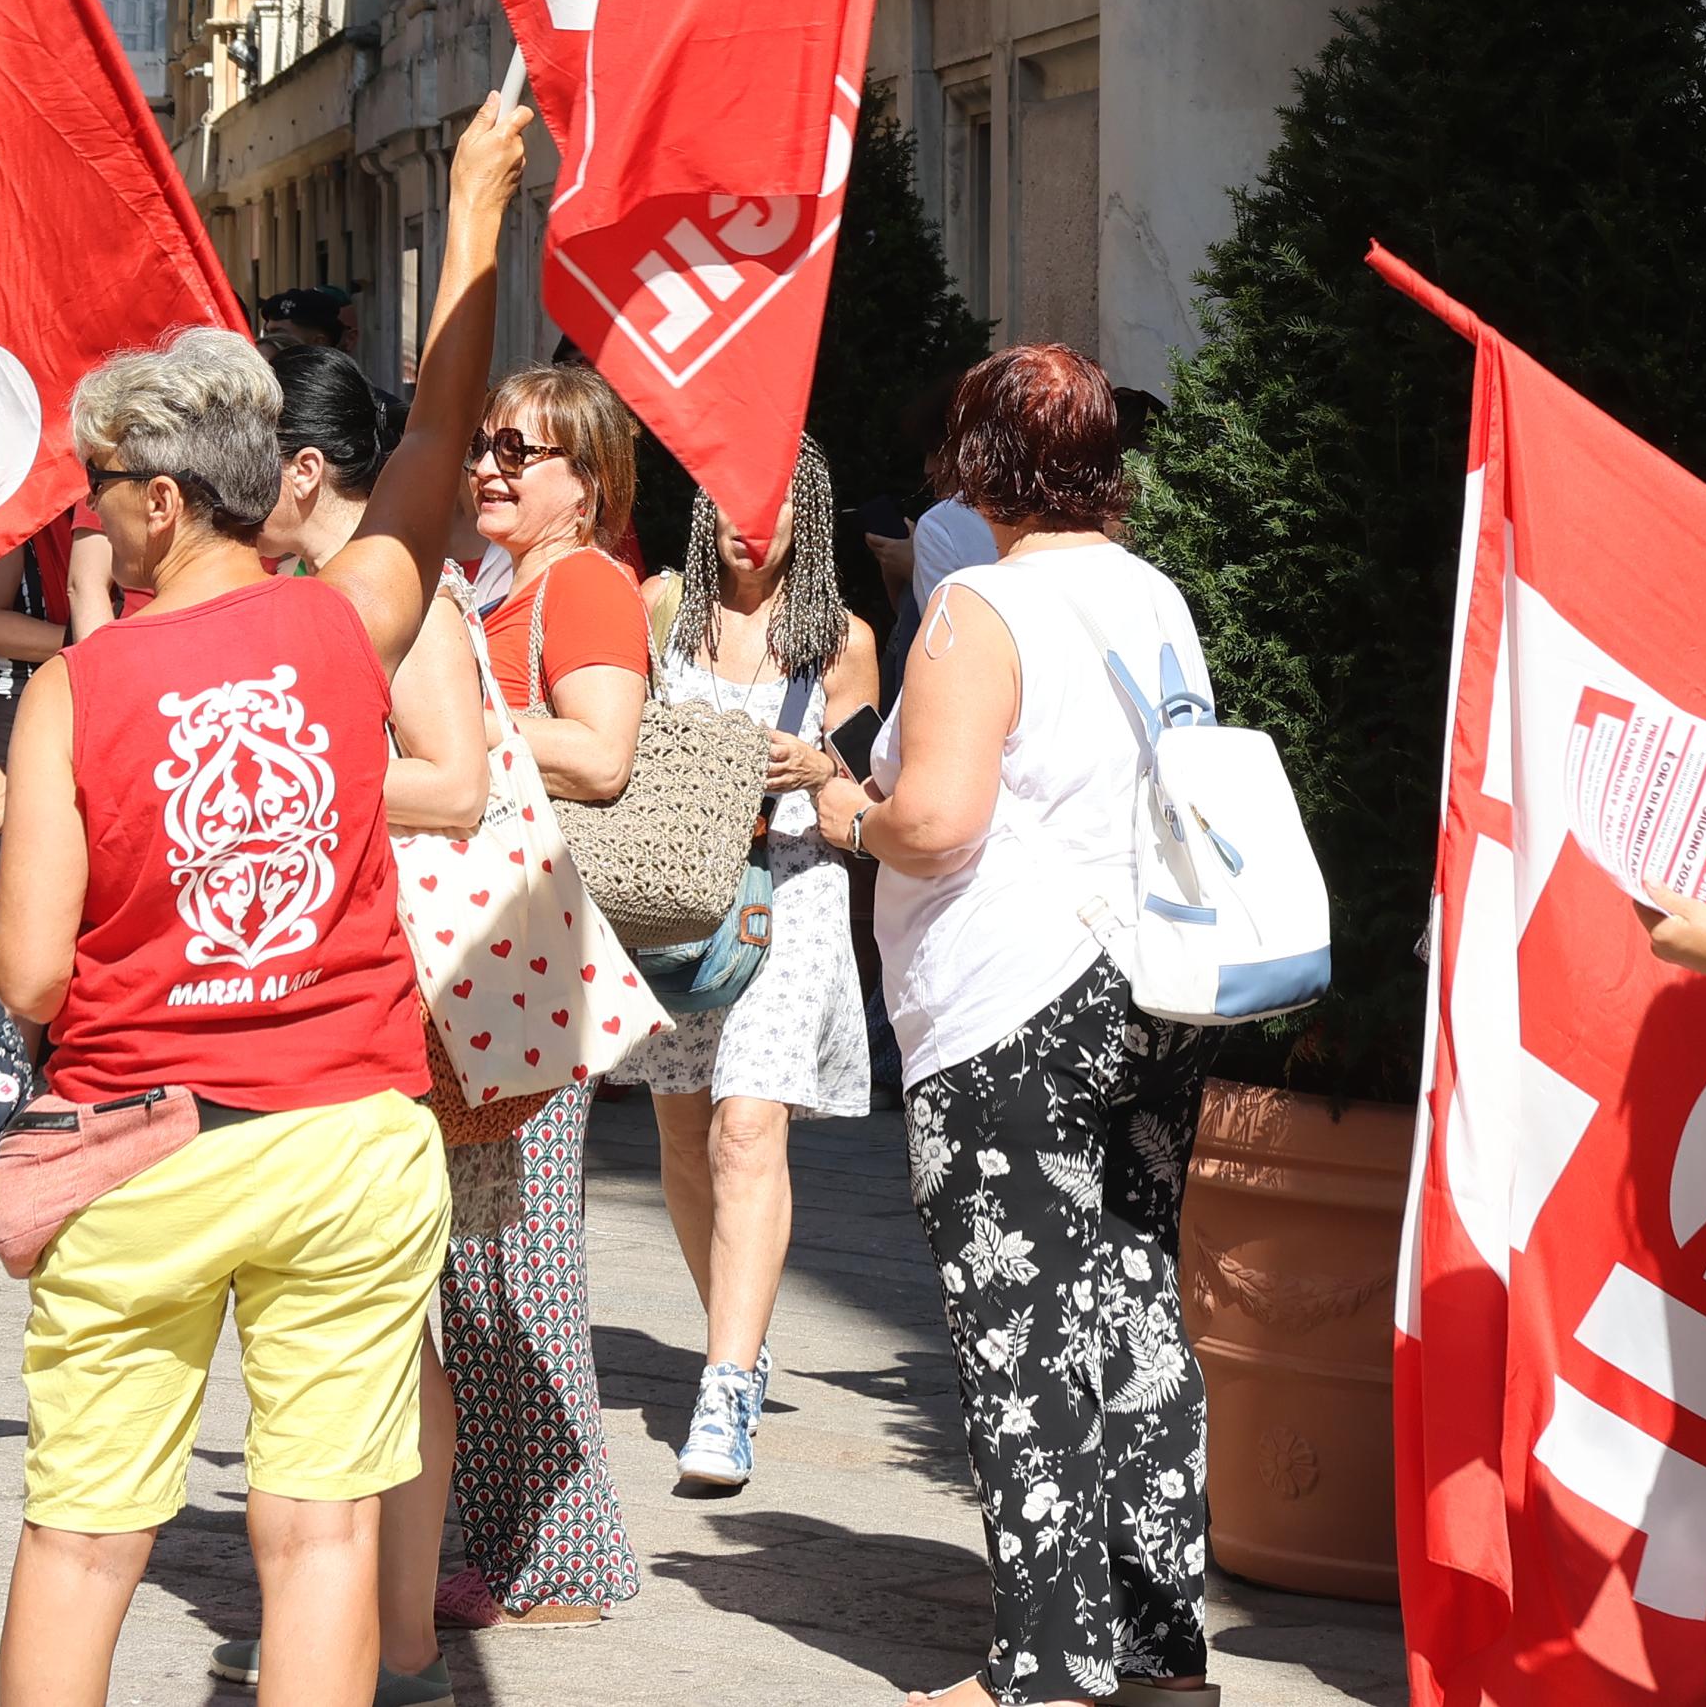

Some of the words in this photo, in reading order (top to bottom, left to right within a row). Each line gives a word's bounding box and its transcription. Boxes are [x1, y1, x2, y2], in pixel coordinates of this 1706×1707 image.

[1630, 714, 1646, 734] VIA
[1633, 722, 1660, 774] PRESIDIO
[1663, 749, 1680, 761] È
[1610, 737, 1638, 796] GARIBALDI
[1652, 760, 1671, 789] ORA
[1624, 774, 1642, 803] CON
[1647, 790, 1660, 805] DI
[1671, 862, 1693, 895] 2025
[167, 977, 254, 1007] MARSA
